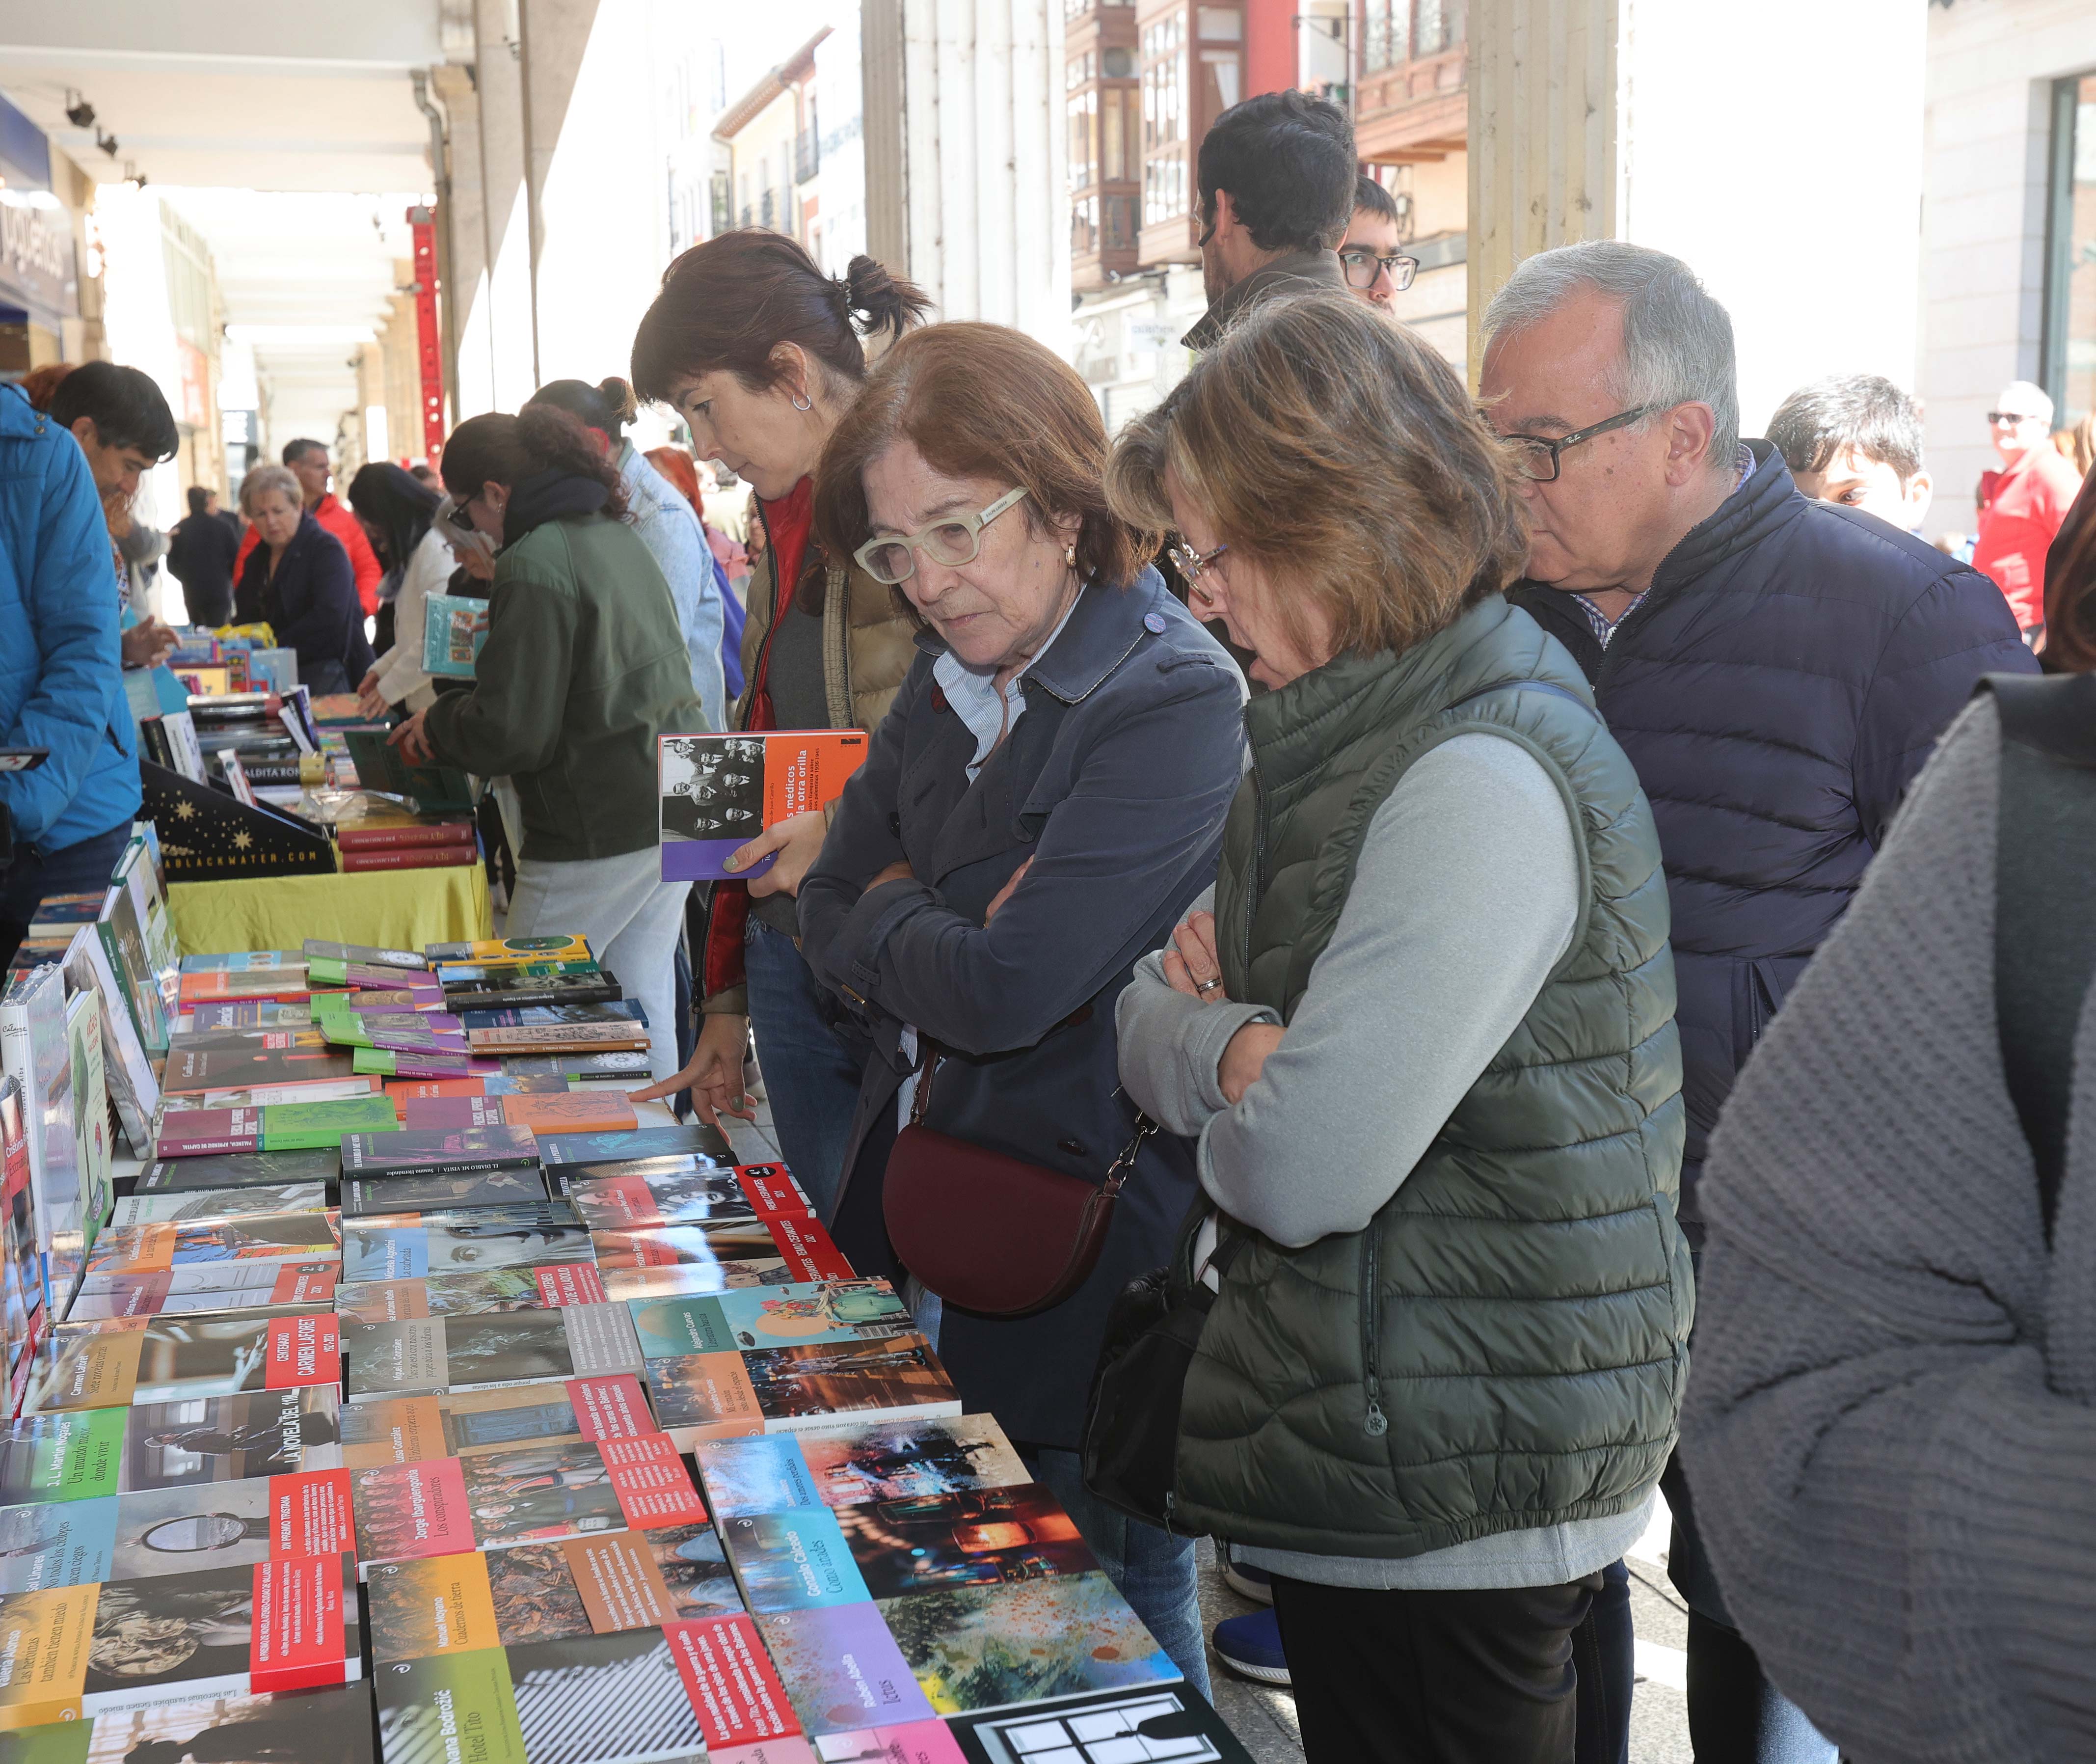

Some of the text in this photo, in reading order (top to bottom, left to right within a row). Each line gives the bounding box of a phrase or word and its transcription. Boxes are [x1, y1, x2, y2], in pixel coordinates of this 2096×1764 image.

[245, 767, 278, 777] ALDITA
[785, 765, 795, 809] médicos
[796, 750, 806, 814] la otra orilla
[559, 1177, 570, 1196] TARANTELLA
[614, 1190, 624, 1199] Rossi
[753, 1179, 778, 1210] PREMIO CERVANTES
[623, 1207, 634, 1220] Cristina
[384, 1239, 398, 1279] Micaela Agostini
[400, 1248, 411, 1270] cachetada
[124, 1303, 136, 1316] Cristina
[131, 1286, 143, 1296] Rossi
[541, 1273, 561, 1304] PREMIO ATENEO
[323, 1333, 335, 1352] 1921-2021
[407, 1325, 417, 1344] nosotros
[421, 1327, 432, 1341] idiotas
[683, 1312, 703, 1349] Alejandro Cuevas
[699, 1313, 718, 1348] Literatura barata
[277, 1332, 290, 1362] CENTENARIO
[298, 1319, 315, 1376] CARMEN LAFORET
[407, 1354, 417, 1363] está
[423, 1353, 433, 1363] odia
[70, 1355, 89, 1396] Carmen Laforet
[86, 1347, 107, 1394] Siete novelas cortas
[407, 1369, 418, 1379] Dios
[423, 1363, 436, 1378] porque
[403, 1404, 417, 1414] aquí
[610, 1384, 638, 1437] cincuenta años después
[706, 1379, 723, 1413] Alejandro Cuevas
[54, 1421, 71, 1445] Nogales
[281, 1394, 301, 1463] LA NOVELA DEL 11M
[405, 1415, 420, 1435] empieza
[50, 1446, 67, 1470] Martín
[67, 1427, 92, 1484] Un mundo mejor
[391, 1427, 404, 1463] Luisa González
[408, 1435, 421, 1456] infierno
[90, 1441, 110, 1481] donde vivir
[785, 1459, 810, 1506] Dos amores perdidos
[405, 1469, 430, 1540] Jorge Ibargüengoitia
[427, 1476, 449, 1537] Los conspiradores
[281, 1495, 291, 1550] XIV PREMIO TRISTANA
[44, 1521, 73, 1589] No todos los cíclopes
[785, 1530, 821, 1597] Gonzalo Calcedo
[809, 1539, 843, 1594] Como ánades
[25, 1555, 46, 1591] Sol Linares
[449, 1582, 462, 1601] tierra
[433, 1597, 450, 1648] Manuel Moyano
[452, 1610, 469, 1645] Cuadernos
[39, 1602, 67, 1682] también tienen miedo
[679, 1630, 691, 1646] exilio
[14, 1637, 39, 1685] Las heroínas
[688, 1656, 706, 1676] guerra
[188, 1691, 221, 1701] heroínas
[840, 1653, 878, 1709] Rubén Abella
[878, 1679, 901, 1706] Ictus
[98, 1706, 124, 1715] miedo
[126, 1702, 151, 1710] tienen
[153, 1697, 187, 1707] también
[701, 1692, 720, 1716] realidad
[463, 1712, 488, 1763] Hotel Tito
[715, 1716, 727, 1731] dura
[720, 1730, 731, 1740] La
